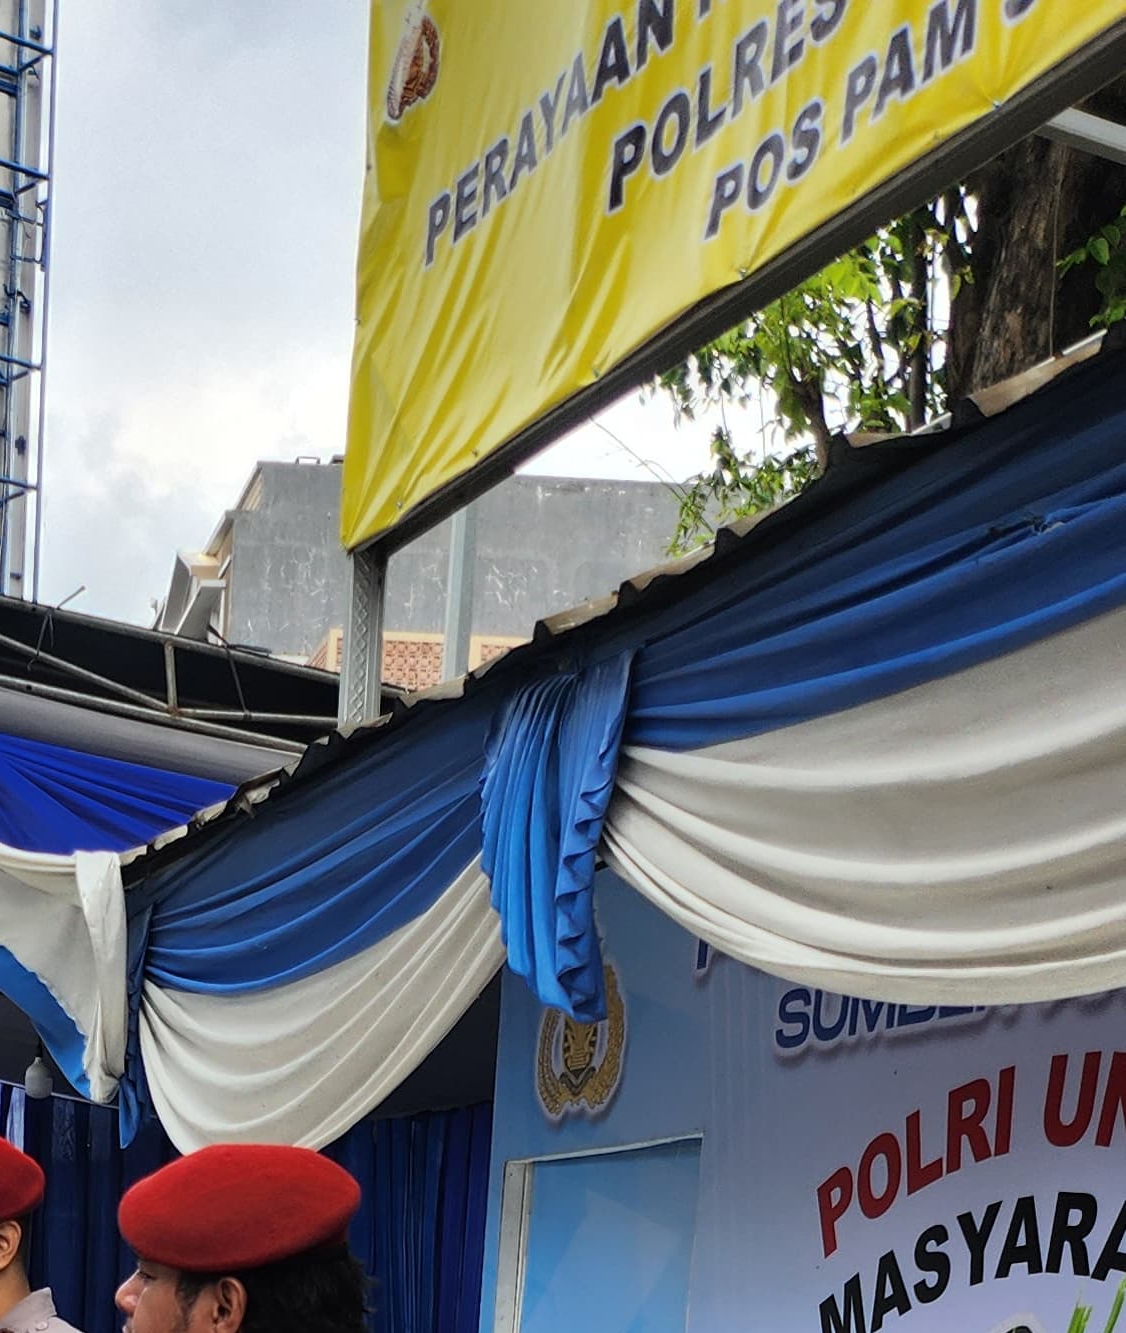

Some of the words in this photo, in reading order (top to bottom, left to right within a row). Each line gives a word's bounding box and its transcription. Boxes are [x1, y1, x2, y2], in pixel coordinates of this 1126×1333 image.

[425, 0, 674, 266] PERAYAAN
[609, 0, 847, 212] POLRES
[705, 101, 822, 240] POS
[841, 0, 974, 144] PAM
[817, 1065, 1016, 1260] POLRI
